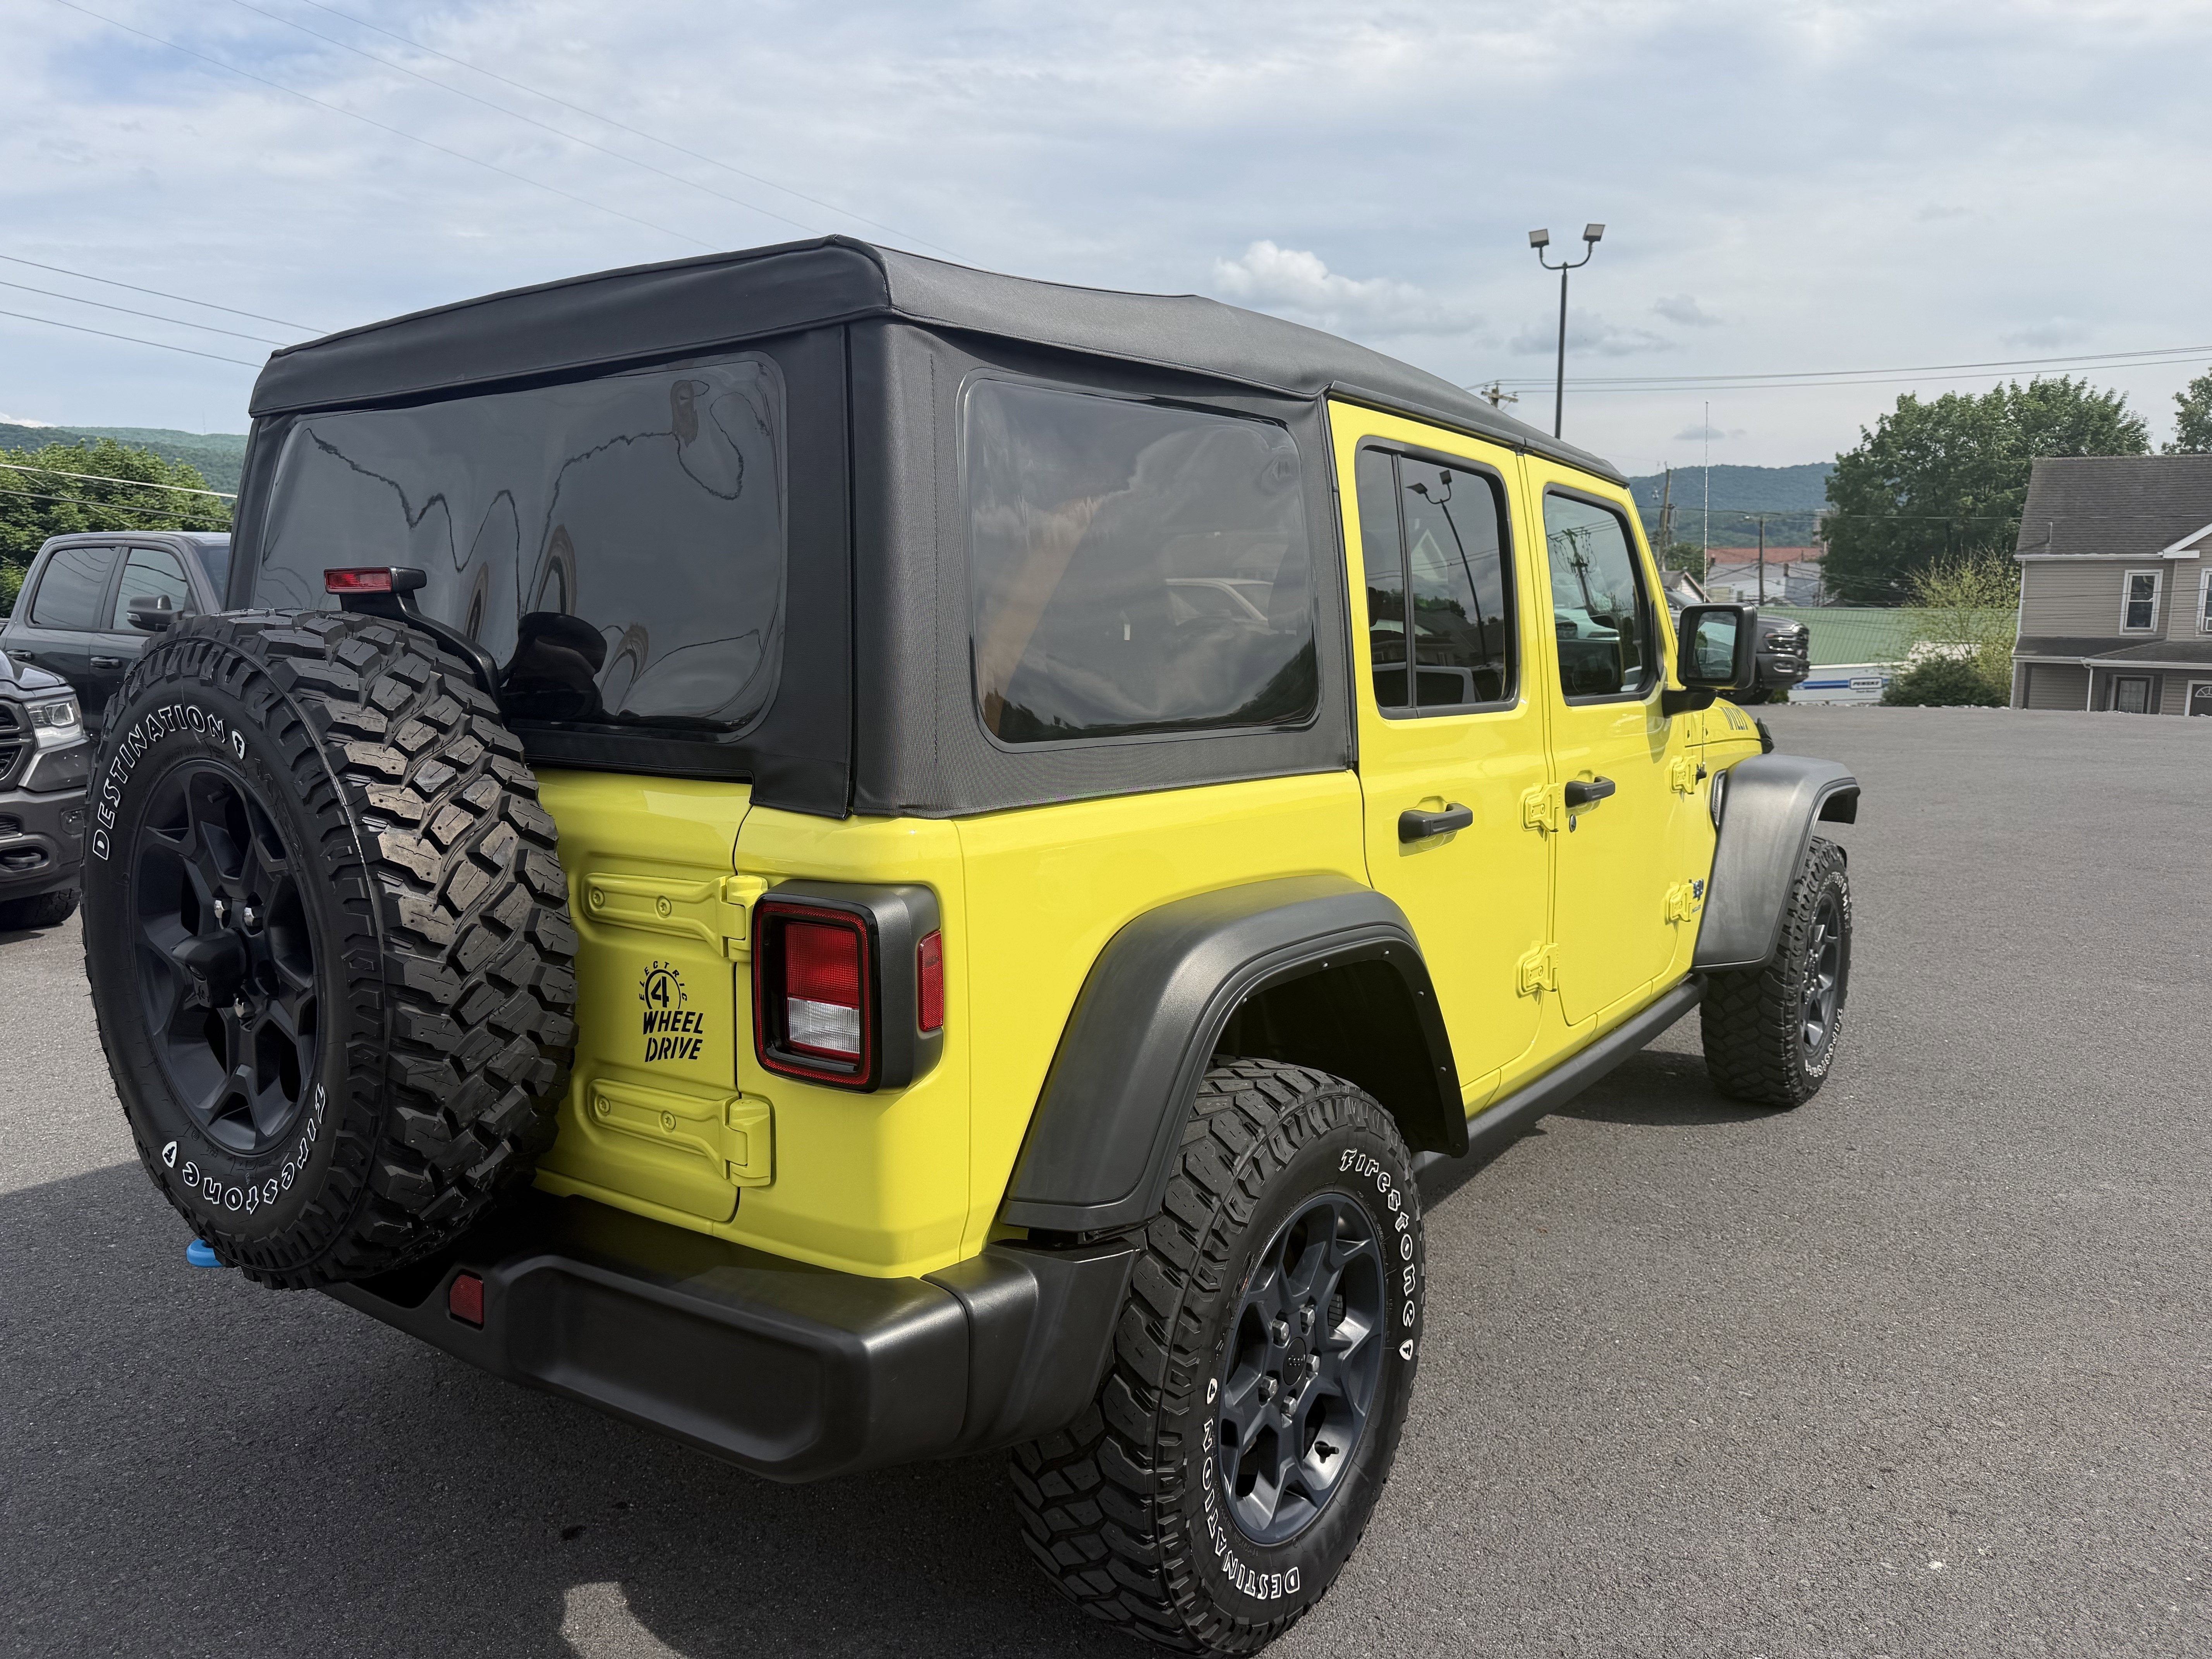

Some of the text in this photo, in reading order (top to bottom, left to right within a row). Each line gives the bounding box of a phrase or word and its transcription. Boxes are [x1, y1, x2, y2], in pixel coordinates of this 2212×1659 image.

[93, 704, 225, 861] DESTINATION
[639, 960, 687, 1001] ELECTRIC
[643, 1010, 704, 1035] WHEEL
[651, 976, 669, 1008] 4
[645, 1036, 703, 1062] DRIVE
[182, 1083, 327, 1215] Firestone
[1339, 1147, 1416, 1328] Firestone
[1202, 1418, 1300, 1600] DESTINATION
